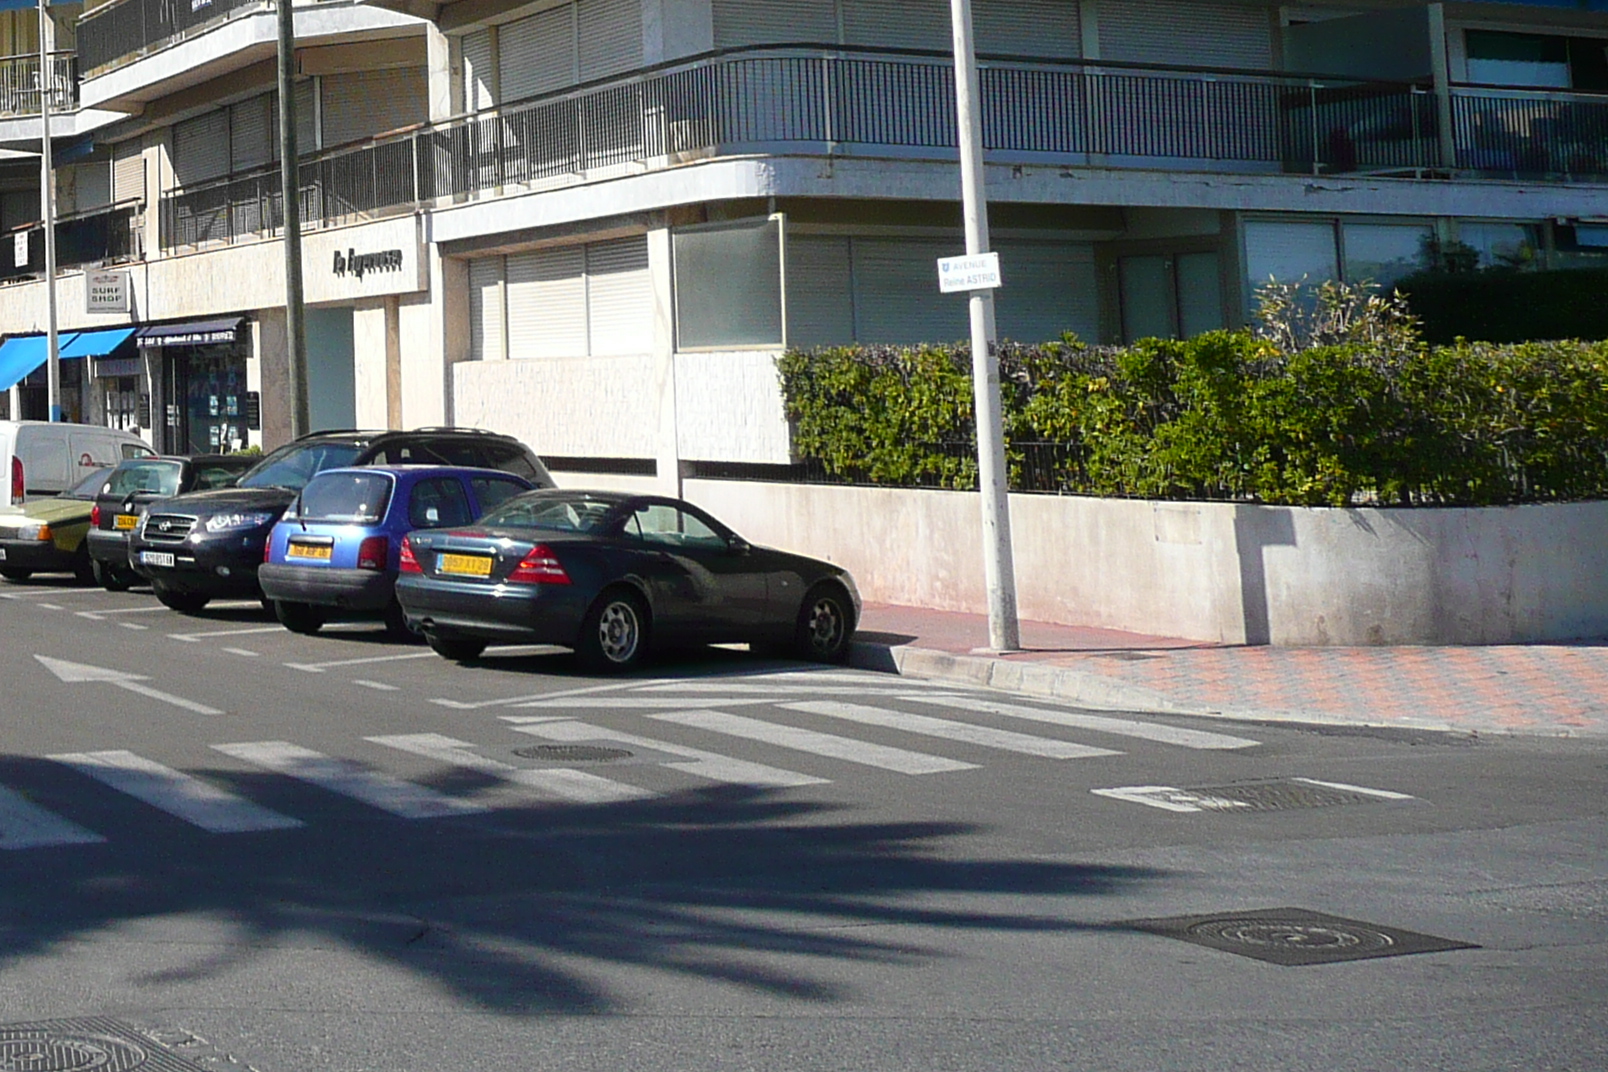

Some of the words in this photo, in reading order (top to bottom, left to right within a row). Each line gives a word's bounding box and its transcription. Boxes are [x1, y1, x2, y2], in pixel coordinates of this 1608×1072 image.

[953, 259, 987, 271] AVENUE
[943, 277, 965, 288] Reine
[967, 272, 996, 285] ASTRID
